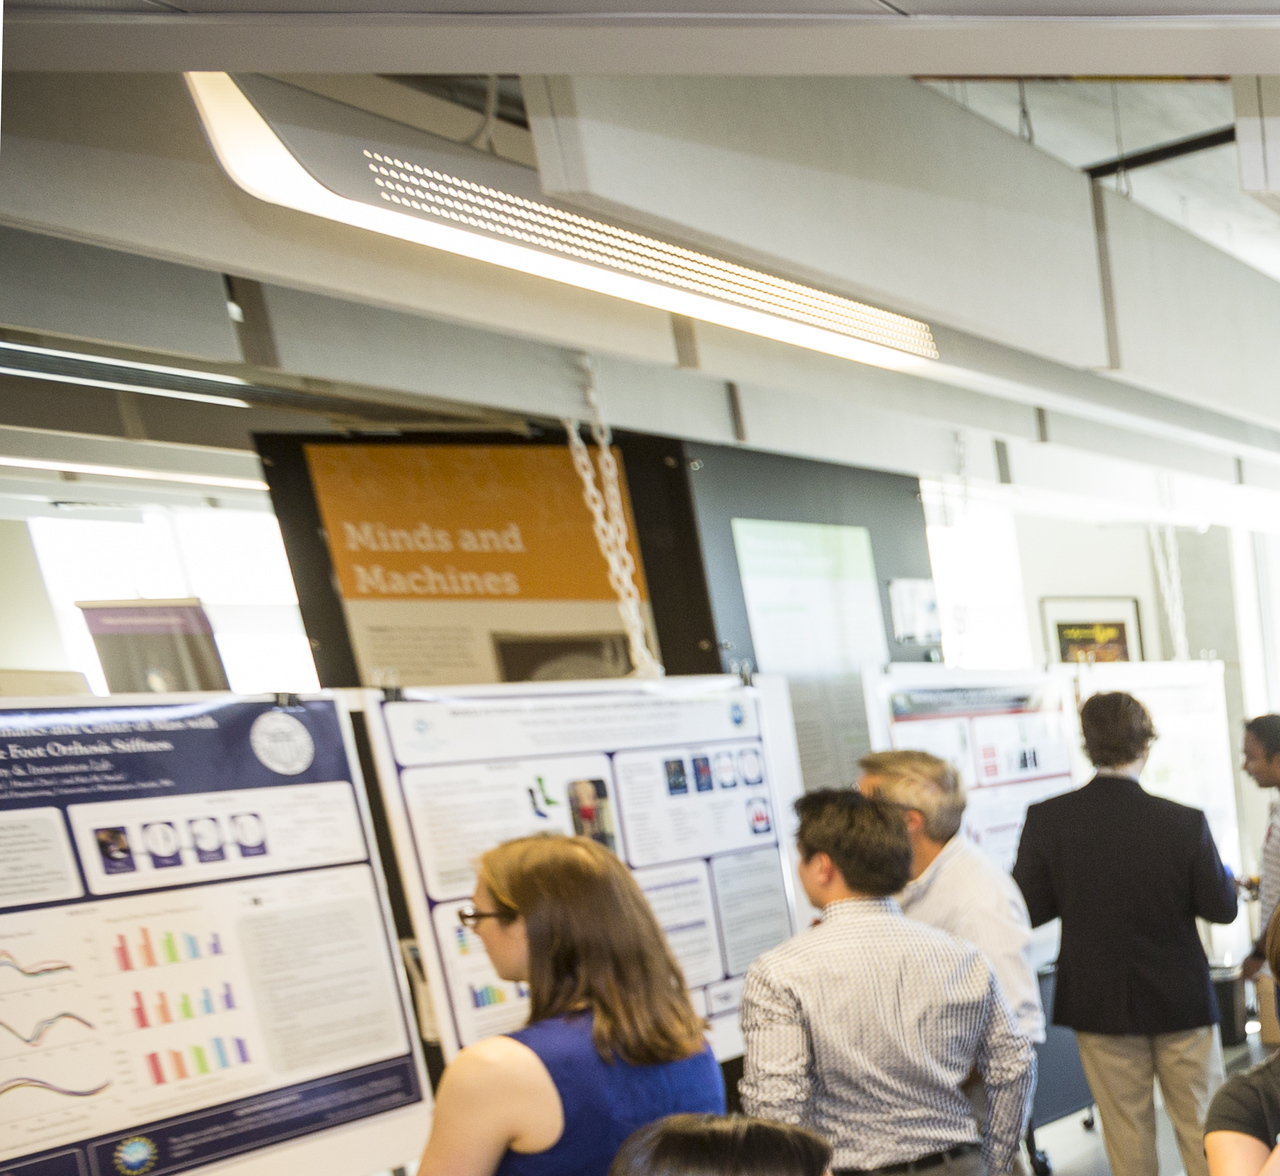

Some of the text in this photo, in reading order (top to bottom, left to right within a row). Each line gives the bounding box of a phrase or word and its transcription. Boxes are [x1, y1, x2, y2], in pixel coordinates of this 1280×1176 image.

[344, 521, 527, 553] Minds and
[352, 563, 521, 595] Machines
